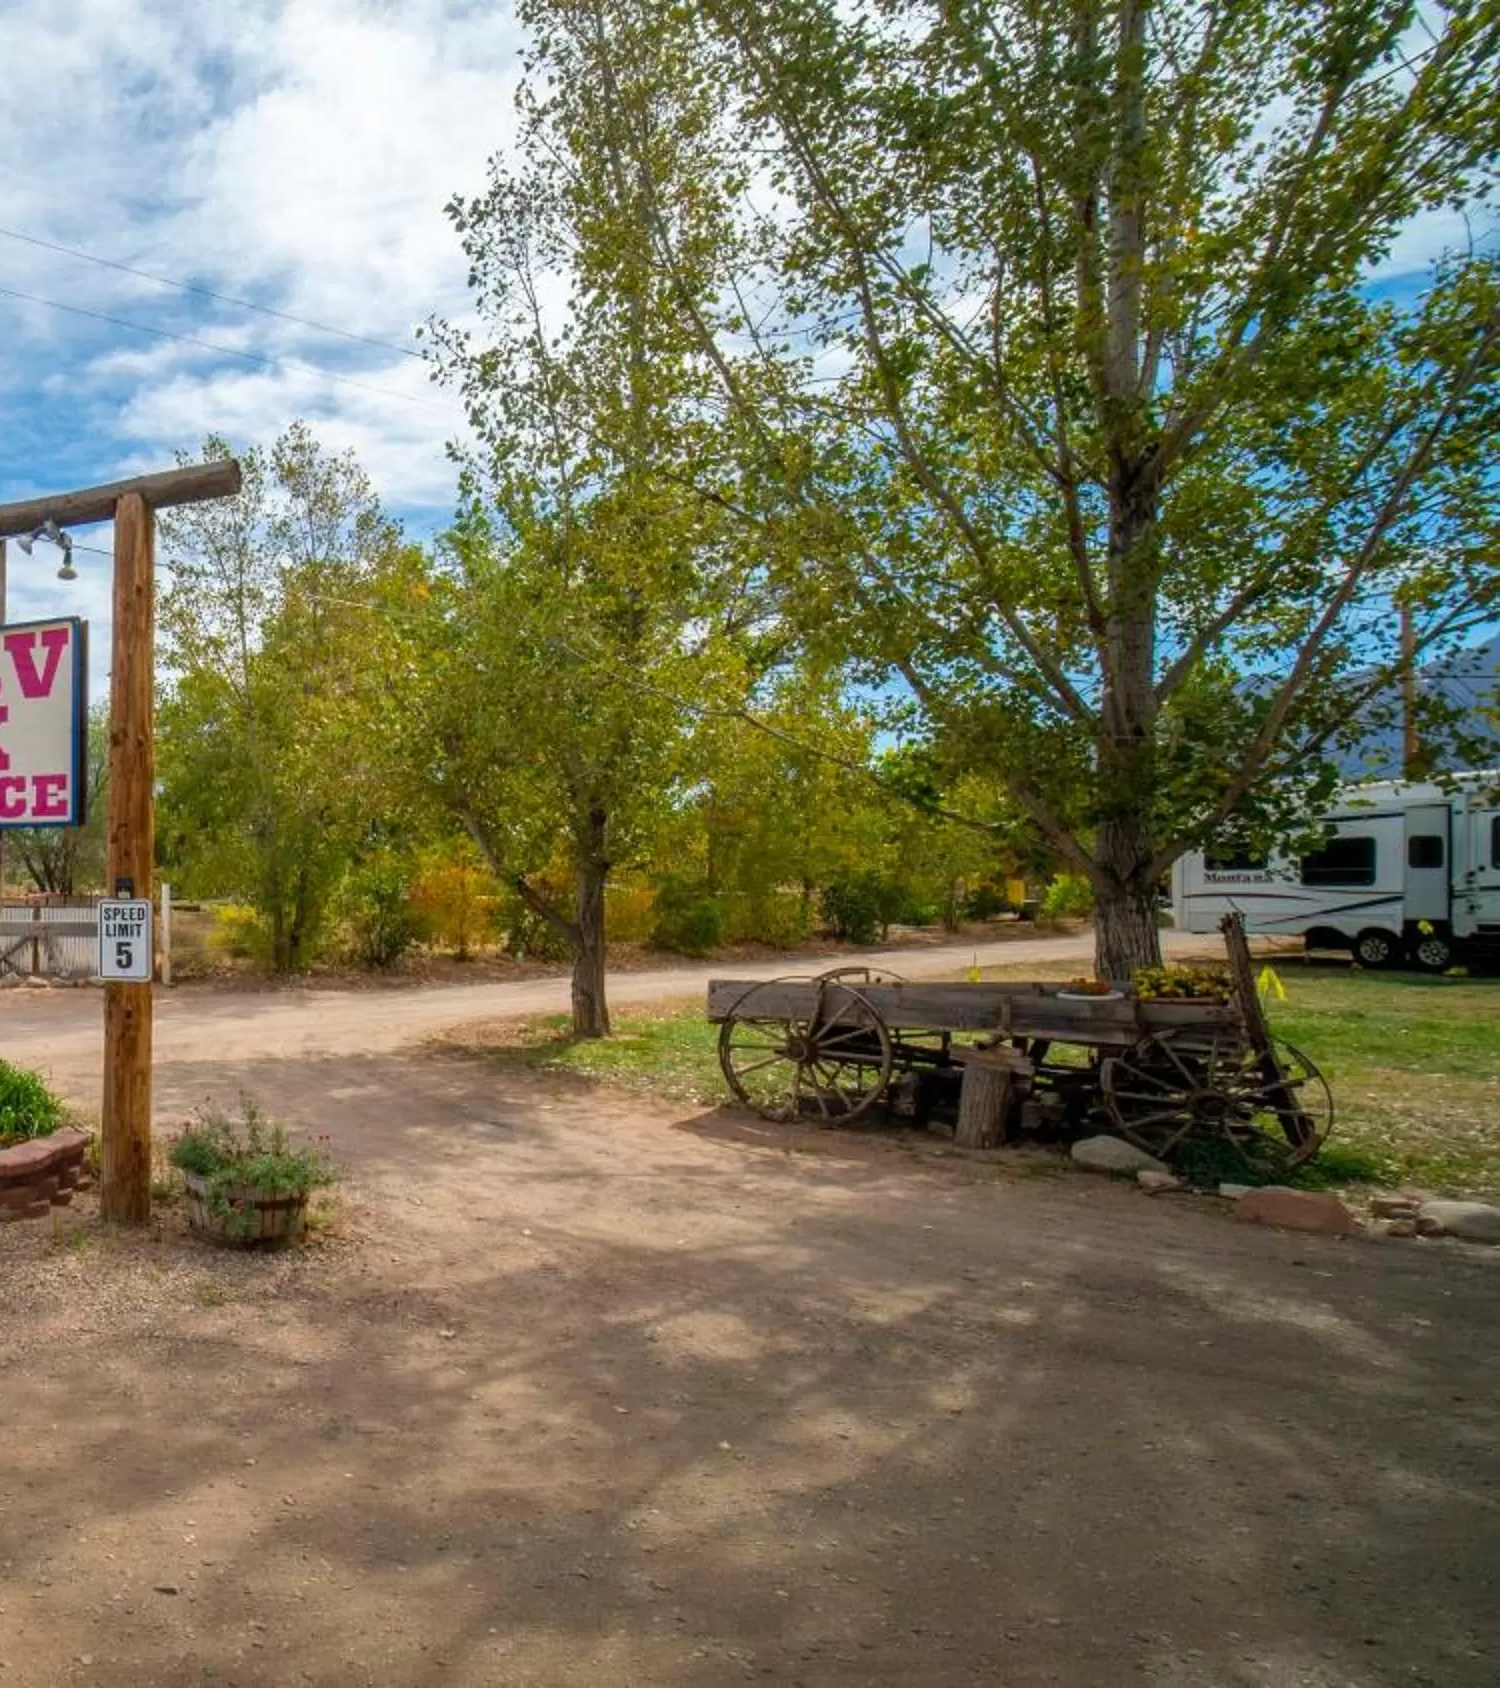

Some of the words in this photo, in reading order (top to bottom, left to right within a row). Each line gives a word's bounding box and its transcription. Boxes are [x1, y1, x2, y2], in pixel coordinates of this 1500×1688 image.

[103, 907, 145, 921] SPEED
[105, 923, 143, 937] LIMIT
[115, 941, 133, 969] 5
